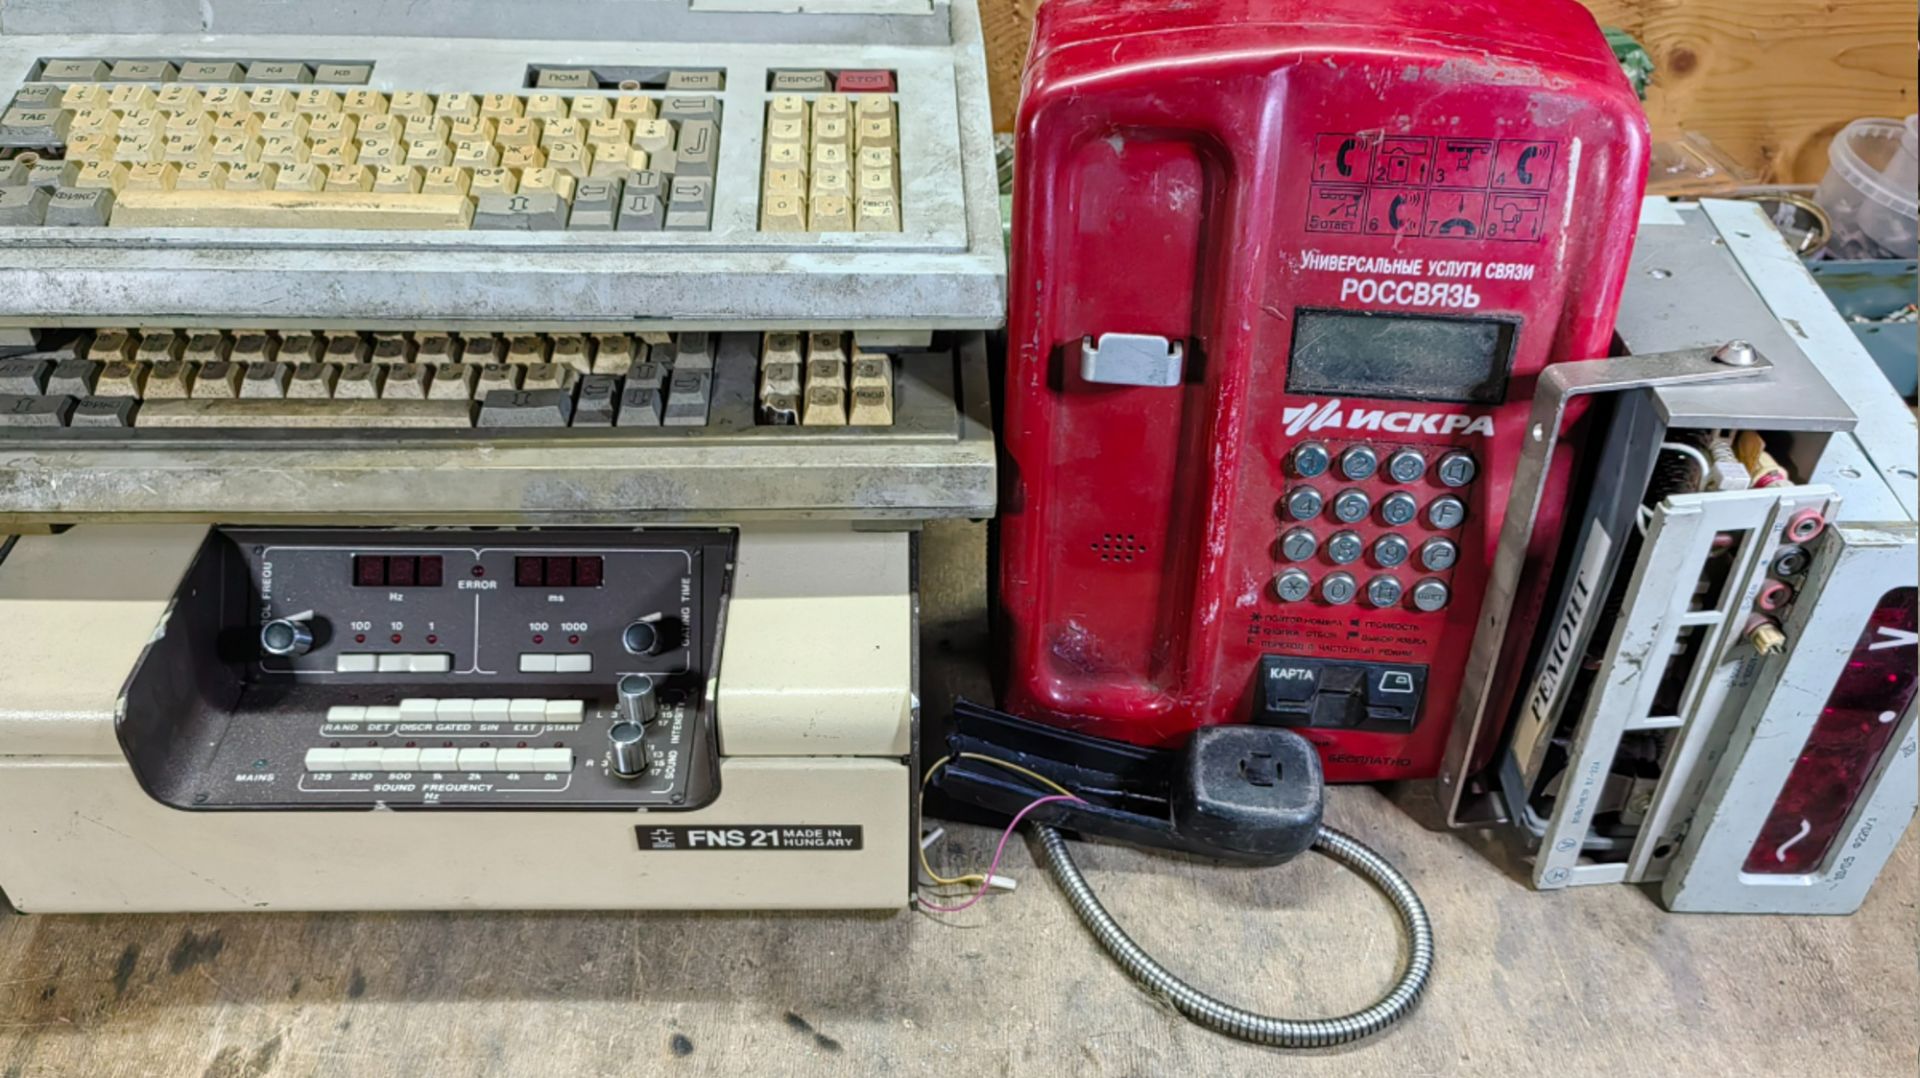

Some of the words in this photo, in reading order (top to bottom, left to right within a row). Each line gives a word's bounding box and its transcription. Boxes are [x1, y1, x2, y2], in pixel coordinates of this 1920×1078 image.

[778, 75, 822, 83] СБРОС
[846, 75, 884, 83] СТОП
[20, 113, 47, 121] ТАБ
[1319, 163, 1326, 178] 1
[1376, 166, 1387, 181] 2
[1435, 168, 1445, 183] 3
[1369, 218, 1379, 231] 6
[1429, 220, 1439, 235] 7
[1487, 223, 1498, 237] 8
[1300, 250, 1423, 276] УНИВЕРСАЛЬНЫЕ
[1427, 260, 1482, 278] УСЛУГИ
[1485, 262, 1535, 281] СВЯЗИ
[1340, 278, 1481, 308] РОССВЯЗЬ
[1347, 408, 1495, 437] ИСКРА
[1297, 498, 1314, 515] 4
[1345, 501, 1359, 518] 5
[1439, 504, 1457, 522] F
[262, 561, 273, 600] FREQU
[458, 580, 497, 589] ERROR
[681, 577, 691, 602] TIME
[389, 592, 404, 601] Hz
[548, 595, 564, 603] ms
[351, 622, 371, 631] 100
[391, 622, 404, 631] 10
[529, 623, 549, 631] 100
[561, 623, 588, 631] 1000
[1531, 570, 1589, 723] РЕМОНТ
[1269, 667, 1315, 681] КАРТА
[235, 773, 275, 782] MAINS
[373, 784, 416, 792] SOUND
[421, 784, 493, 793] FREQUENCY
[424, 792, 440, 800] Hz
[687, 829, 746, 847] FNS
[750, 829, 780, 847] 21
[783, 829, 824, 838] MADE
[828, 829, 842, 838] IN
[783, 838, 853, 847] HUNGARY
